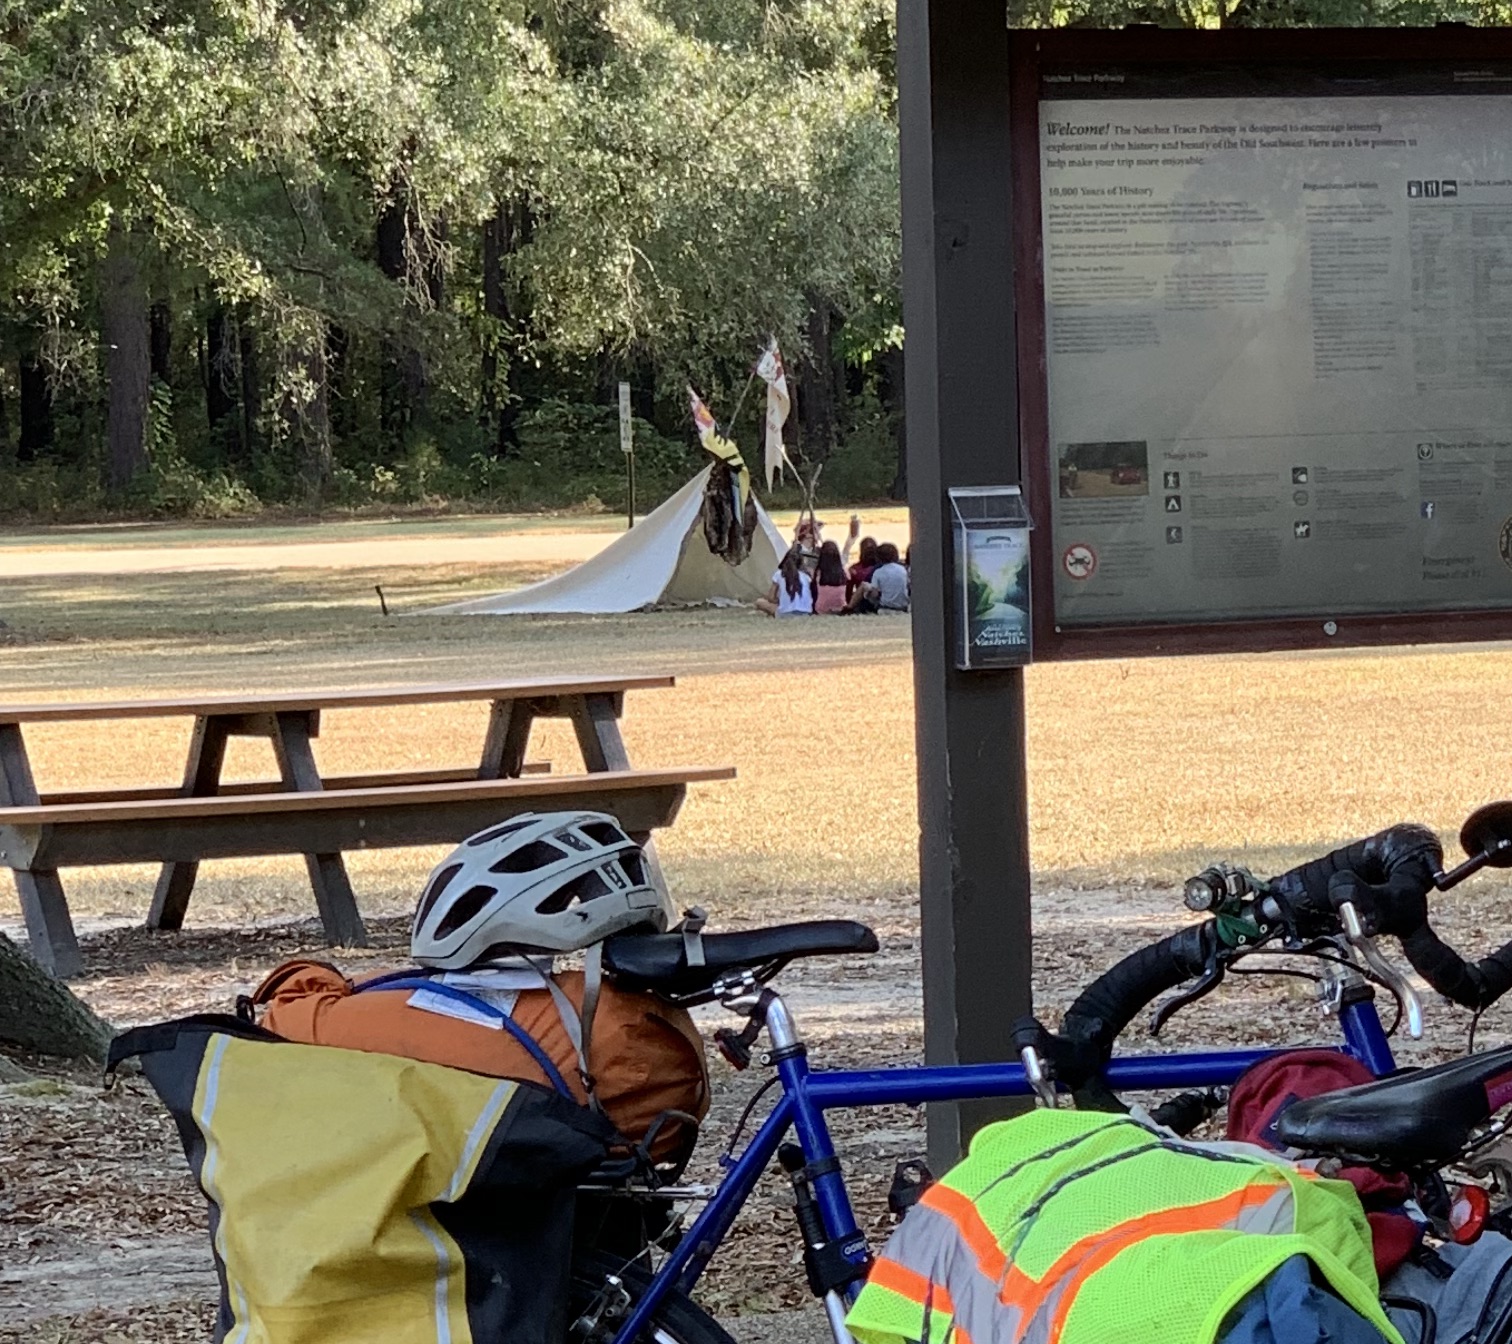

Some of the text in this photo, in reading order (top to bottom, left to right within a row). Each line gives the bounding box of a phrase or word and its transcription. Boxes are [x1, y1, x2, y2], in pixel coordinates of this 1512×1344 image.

[1047, 122, 1110, 136] Welcome!
[1115, 125, 1131, 135] The
[1133, 124, 1170, 135] Natchez
[1173, 124, 1197, 134] Trace
[1200, 124, 1237, 136] Parkway
[1248, 123, 1287, 136] designed
[1046, 142, 1098, 153] exploration
[1099, 141, 1109, 151] of
[1110, 141, 1126, 151] the
[1127, 141, 1160, 152] history
[1161, 141, 1179, 150] and
[1047, 158, 1066, 169] help
[1068, 157, 1093, 167] make
[1094, 158, 1115, 169] your
[1117, 158, 1134, 169] trip
[1136, 158, 1159, 167] more
[1049, 186, 1154, 198] 10,000 Years of History
